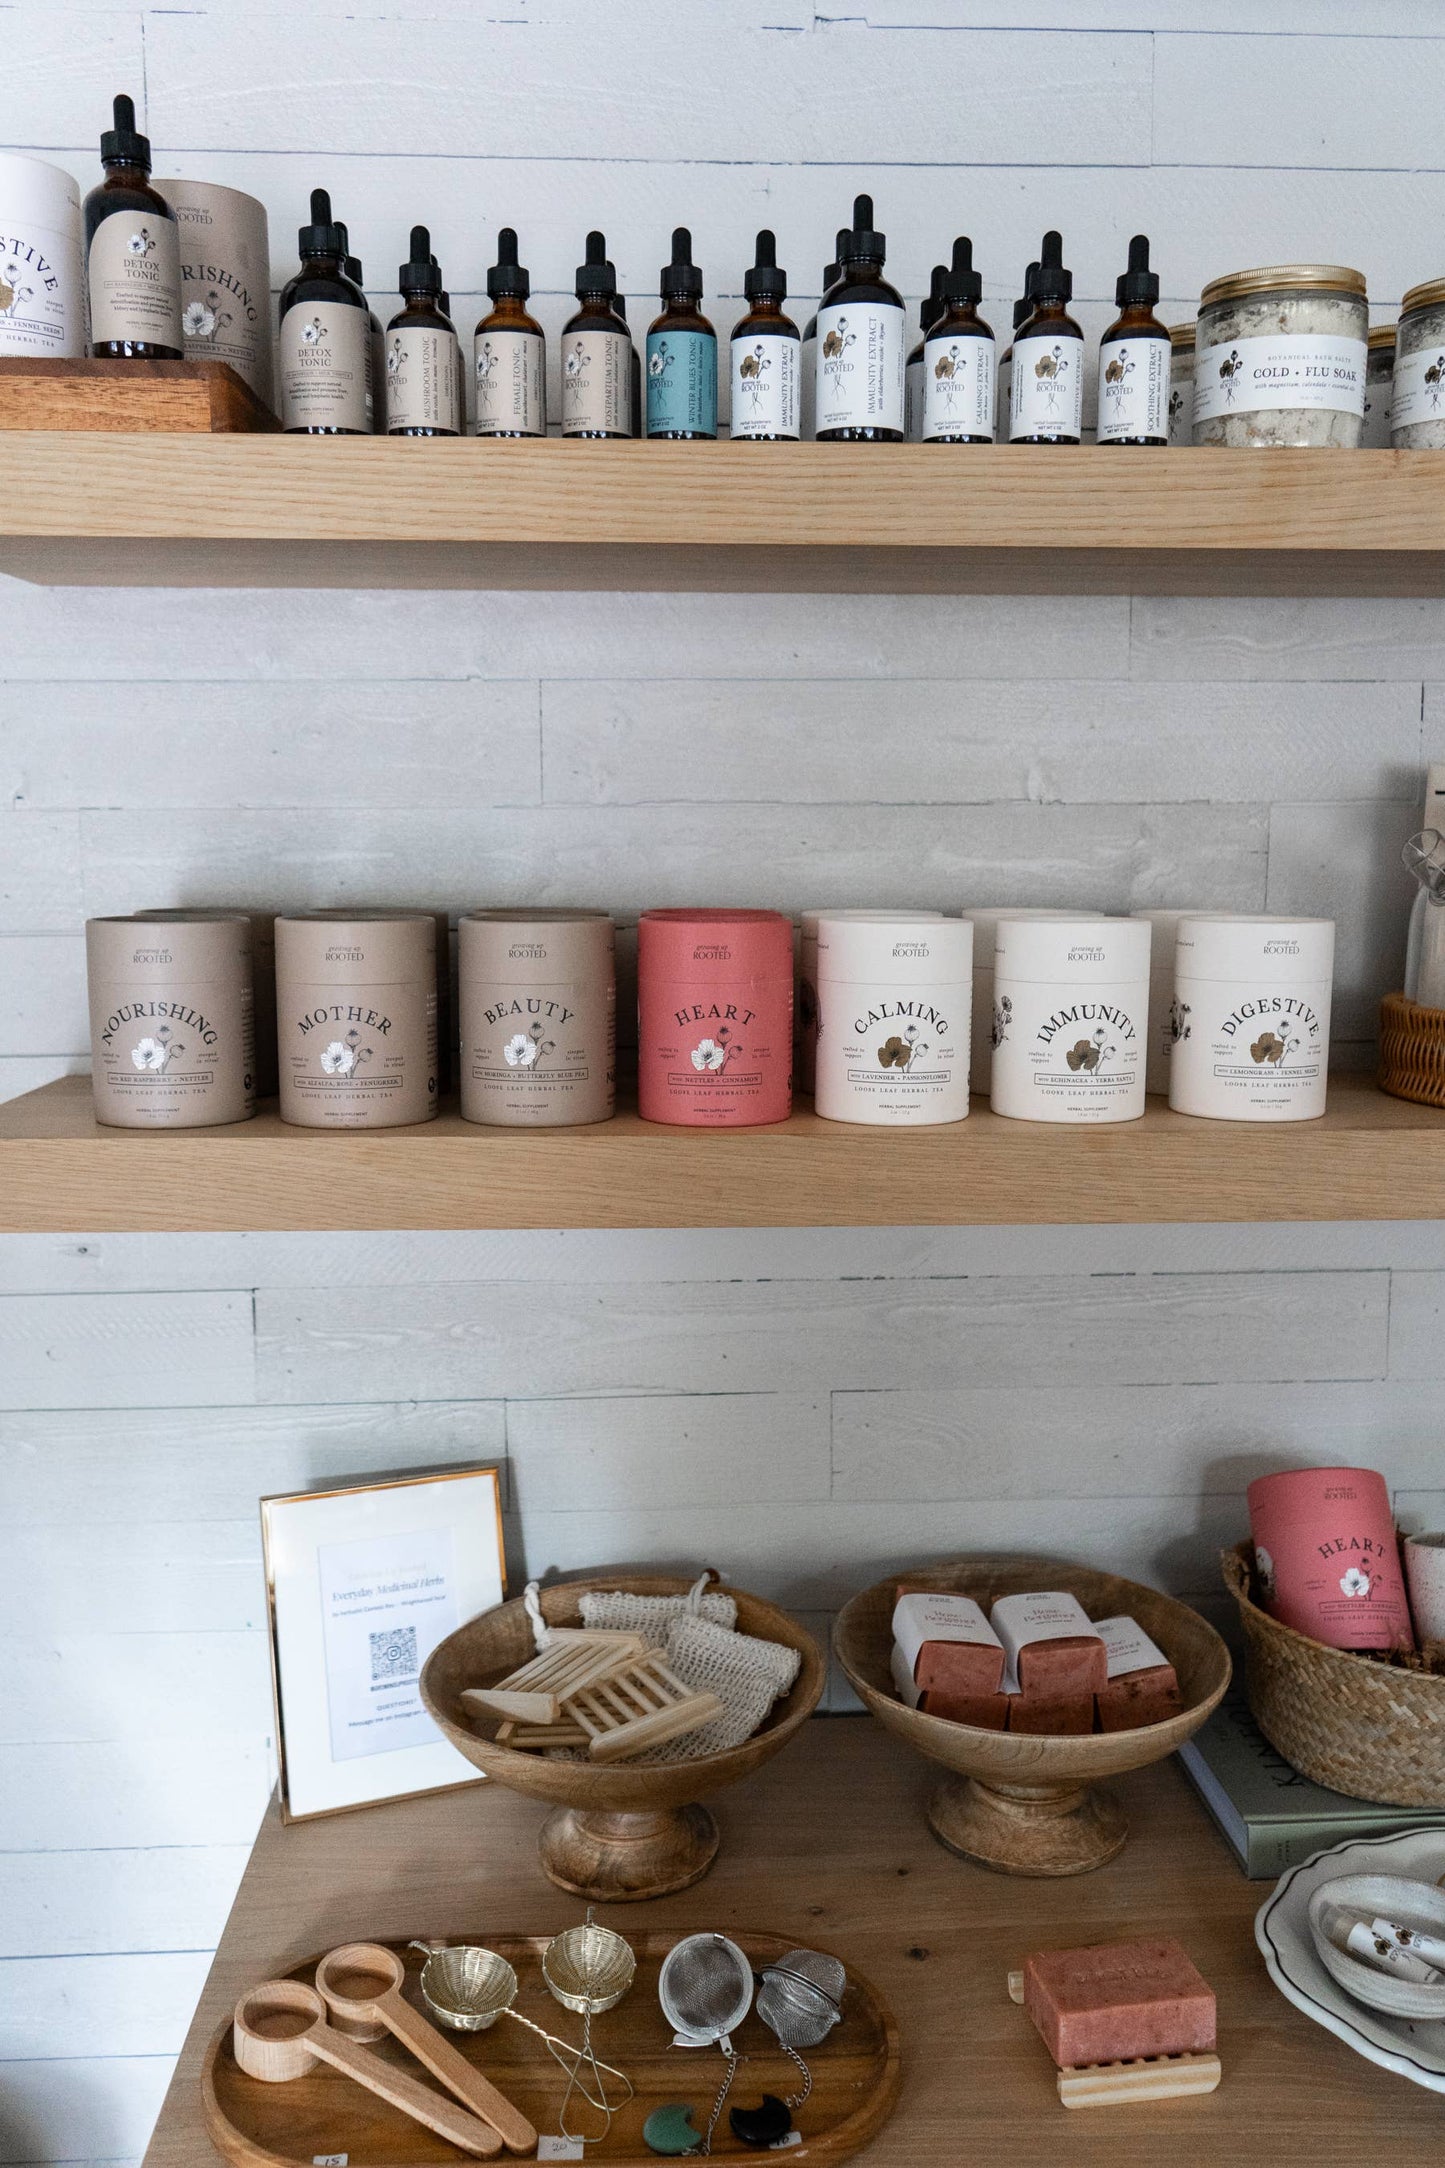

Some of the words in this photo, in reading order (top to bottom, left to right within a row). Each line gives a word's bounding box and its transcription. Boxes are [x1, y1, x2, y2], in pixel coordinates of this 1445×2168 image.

[123, 259, 160, 272] DETOX
[126, 270, 160, 282] TONIC
[422, 336, 430, 365] TONIC
[868, 317, 877, 361] EXTRACT
[298, 348, 332, 358] DETOX
[604, 336, 613, 366] TONIC
[688, 338, 697, 365] TONIC
[781, 344, 789, 381] EXTRACT
[1149, 343, 1157, 382] EXTRACT
[300, 359, 332, 368] TONIC
[512, 348, 521, 378] TONIC
[1253, 367, 1290, 379] COLD
[1305, 366, 1331, 377] FLU
[1333, 369, 1358, 382] SOAK
[688, 368, 697, 392] BLUES
[867, 362, 876, 414] IMMUNITY
[936, 384, 965, 393] ROOTED
[1036, 384, 1067, 393] ROOTED
[423, 366, 431, 419] MUSHROOM
[513, 382, 521, 415] FEMALE
[604, 369, 613, 427] POSTPARTUM
[688, 393, 697, 424] WINTER
[781, 382, 789, 427] IMMUNITY
[1147, 383, 1156, 432] SOOTHING
[325, 952, 365, 961] ROOTED
[508, 950, 547, 959] ROOTED
[693, 950, 732, 960] ROOTED
[892, 948, 930, 958] ROOTED
[895, 941, 920, 949] growing
[1263, 946, 1300, 955] ROOTED
[133, 955, 173, 964] ROOTED
[1067, 952, 1105, 962] ROOTED
[297, 1005, 393, 1037] MOTHER
[483, 998, 575, 1026] BEAUTY
[674, 1003, 757, 1028] HEART
[854, 1001, 949, 1036] CALMING
[1220, 997, 1320, 1039] DIGESTIVE
[101, 1001, 219, 1047] NOURISHING
[1036, 1004, 1136, 1045] IMMUNITY
[484, 1071, 511, 1079] MORINGA
[685, 1076, 714, 1084] NETTLES
[861, 1073, 895, 1081] LAVENDER
[902, 1073, 948, 1081] PASSIONFLOWER
[1050, 1076, 1088, 1084] ECHINACEA
[1229, 1068, 1275, 1076] LEMONGRASS
[1317, 1536, 1387, 1559] HEART
[332, 1588, 373, 1603] Everyday
[376, 1579, 419, 1594] Medicinal
[420, 1574, 445, 1588] Herbs
[552, 2143, 568, 2152] 20
[325, 2156, 341, 2167] 15
